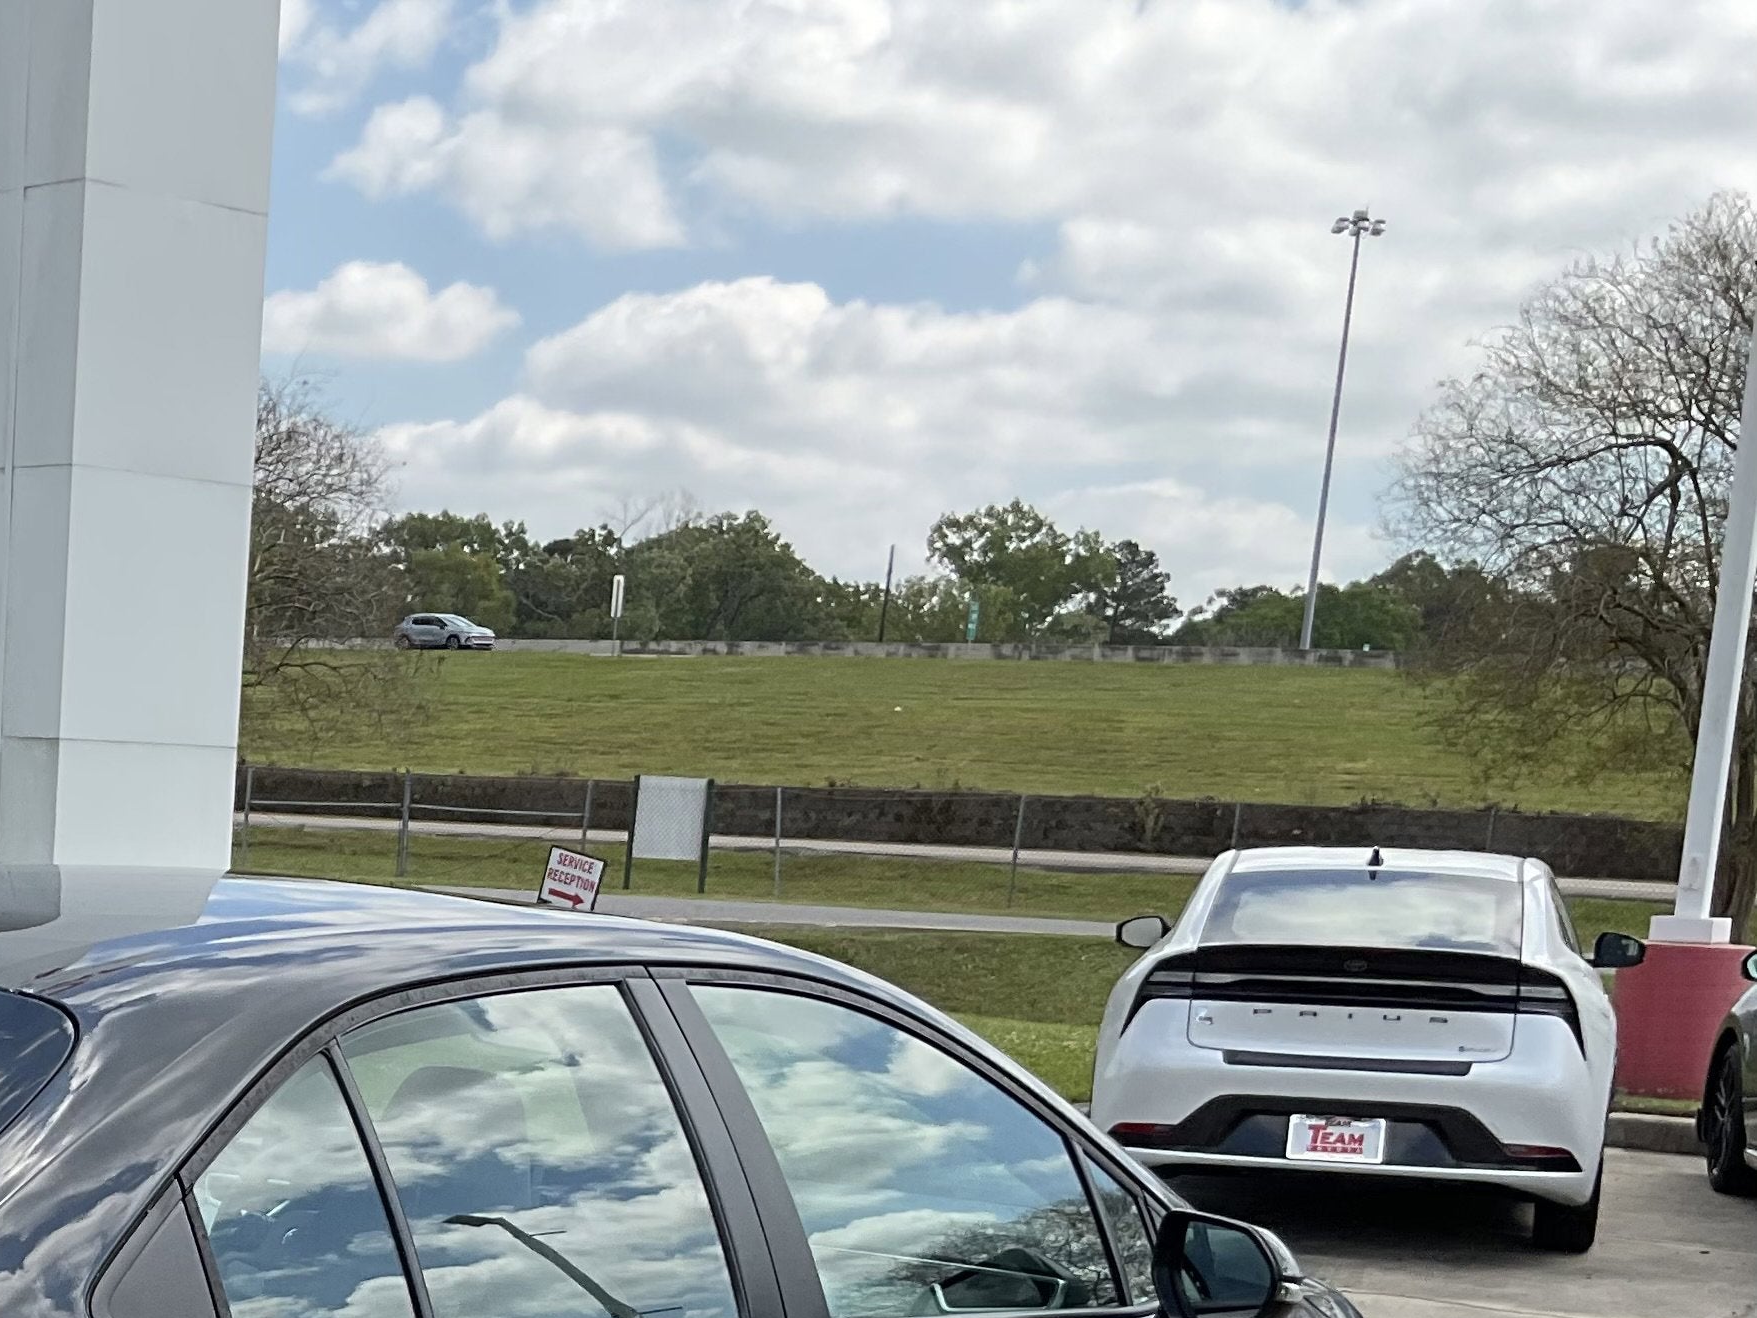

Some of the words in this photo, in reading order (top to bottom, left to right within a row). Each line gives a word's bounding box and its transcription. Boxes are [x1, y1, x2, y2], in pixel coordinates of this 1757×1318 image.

[557, 853, 594, 874] SERVICE
[547, 867, 596, 892] RECEPTION
[1253, 1009, 1448, 1023] PRIUS
[1307, 1124, 1365, 1147] TEAM
